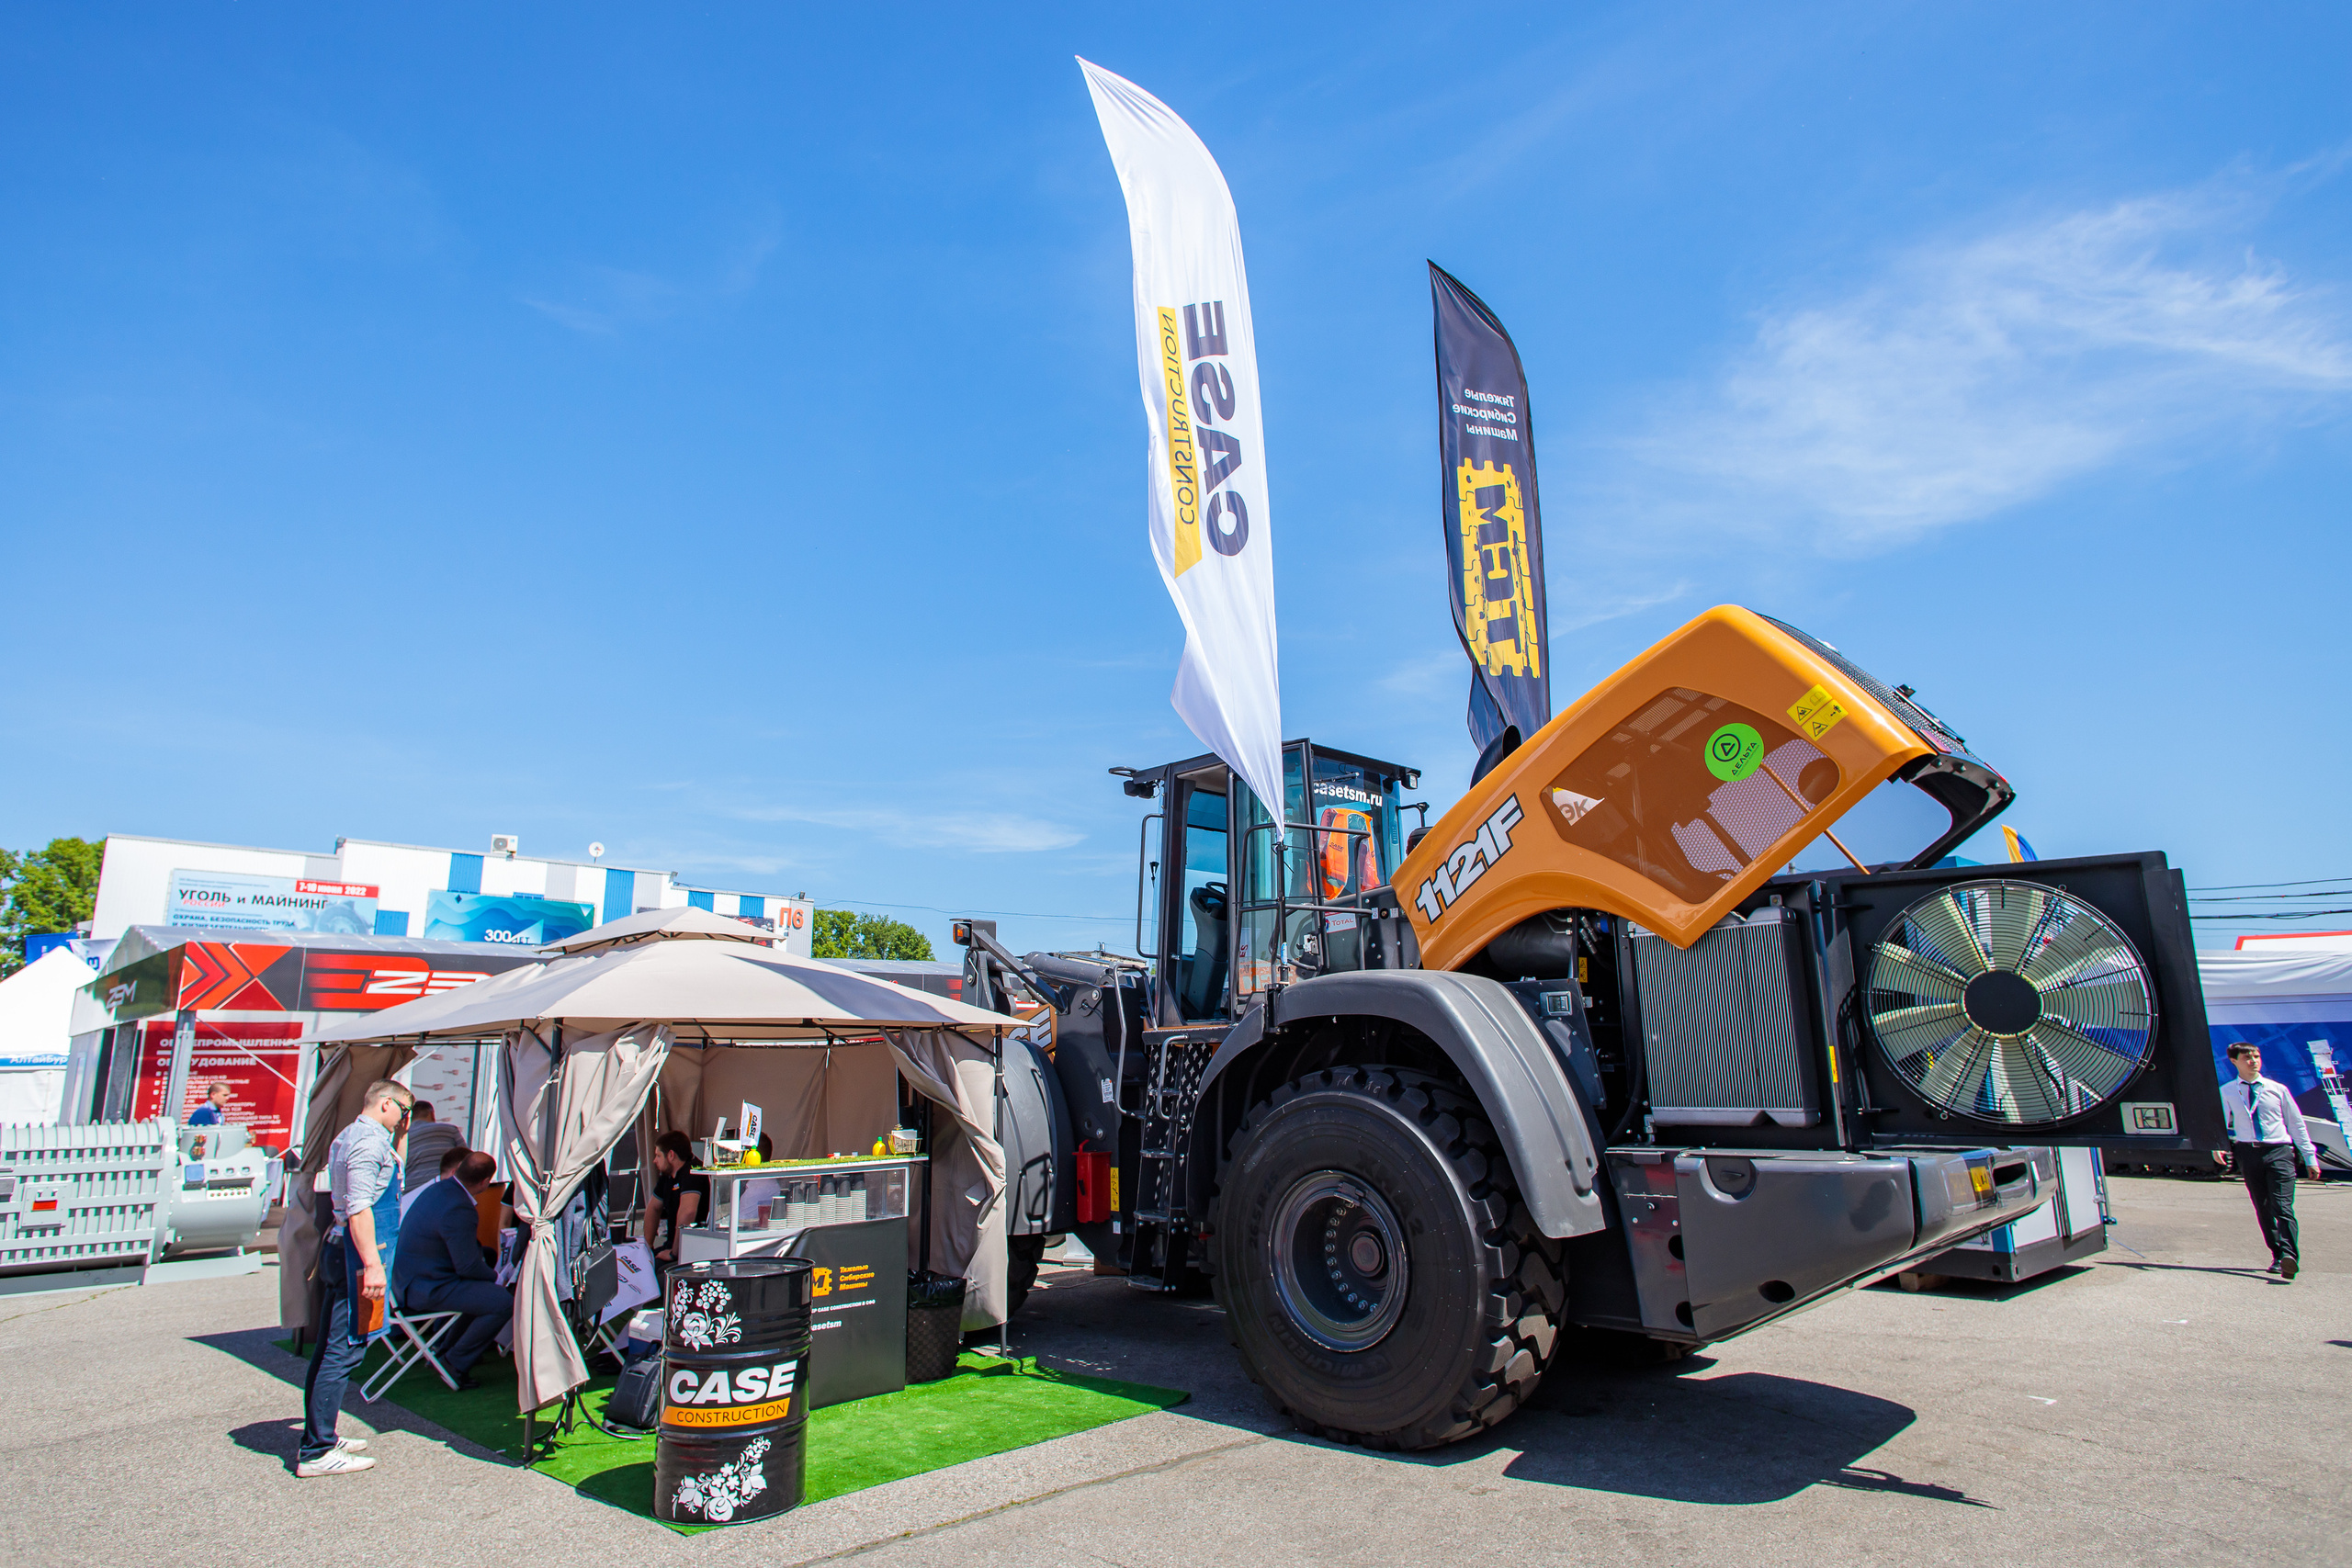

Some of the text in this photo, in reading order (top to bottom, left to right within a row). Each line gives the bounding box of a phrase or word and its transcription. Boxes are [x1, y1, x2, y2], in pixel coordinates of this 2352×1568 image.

[1415, 792, 1525, 925] 1121F
[178, 889, 328, 909] УГОЛЬ и МАЙНИНГ
[345, 885, 368, 897] 2022
[779, 907, 804, 929] П6
[1332, 919, 1354, 927] TOTAL
[484, 929, 512, 943] 300
[748, 1114, 758, 1140] CASE
[620, 1255, 642, 1273] CASE
[838, 1281, 868, 1291] Машины
[669, 1359, 798, 1404] CASE
[676, 1403, 786, 1424] CONSTRUCTION
